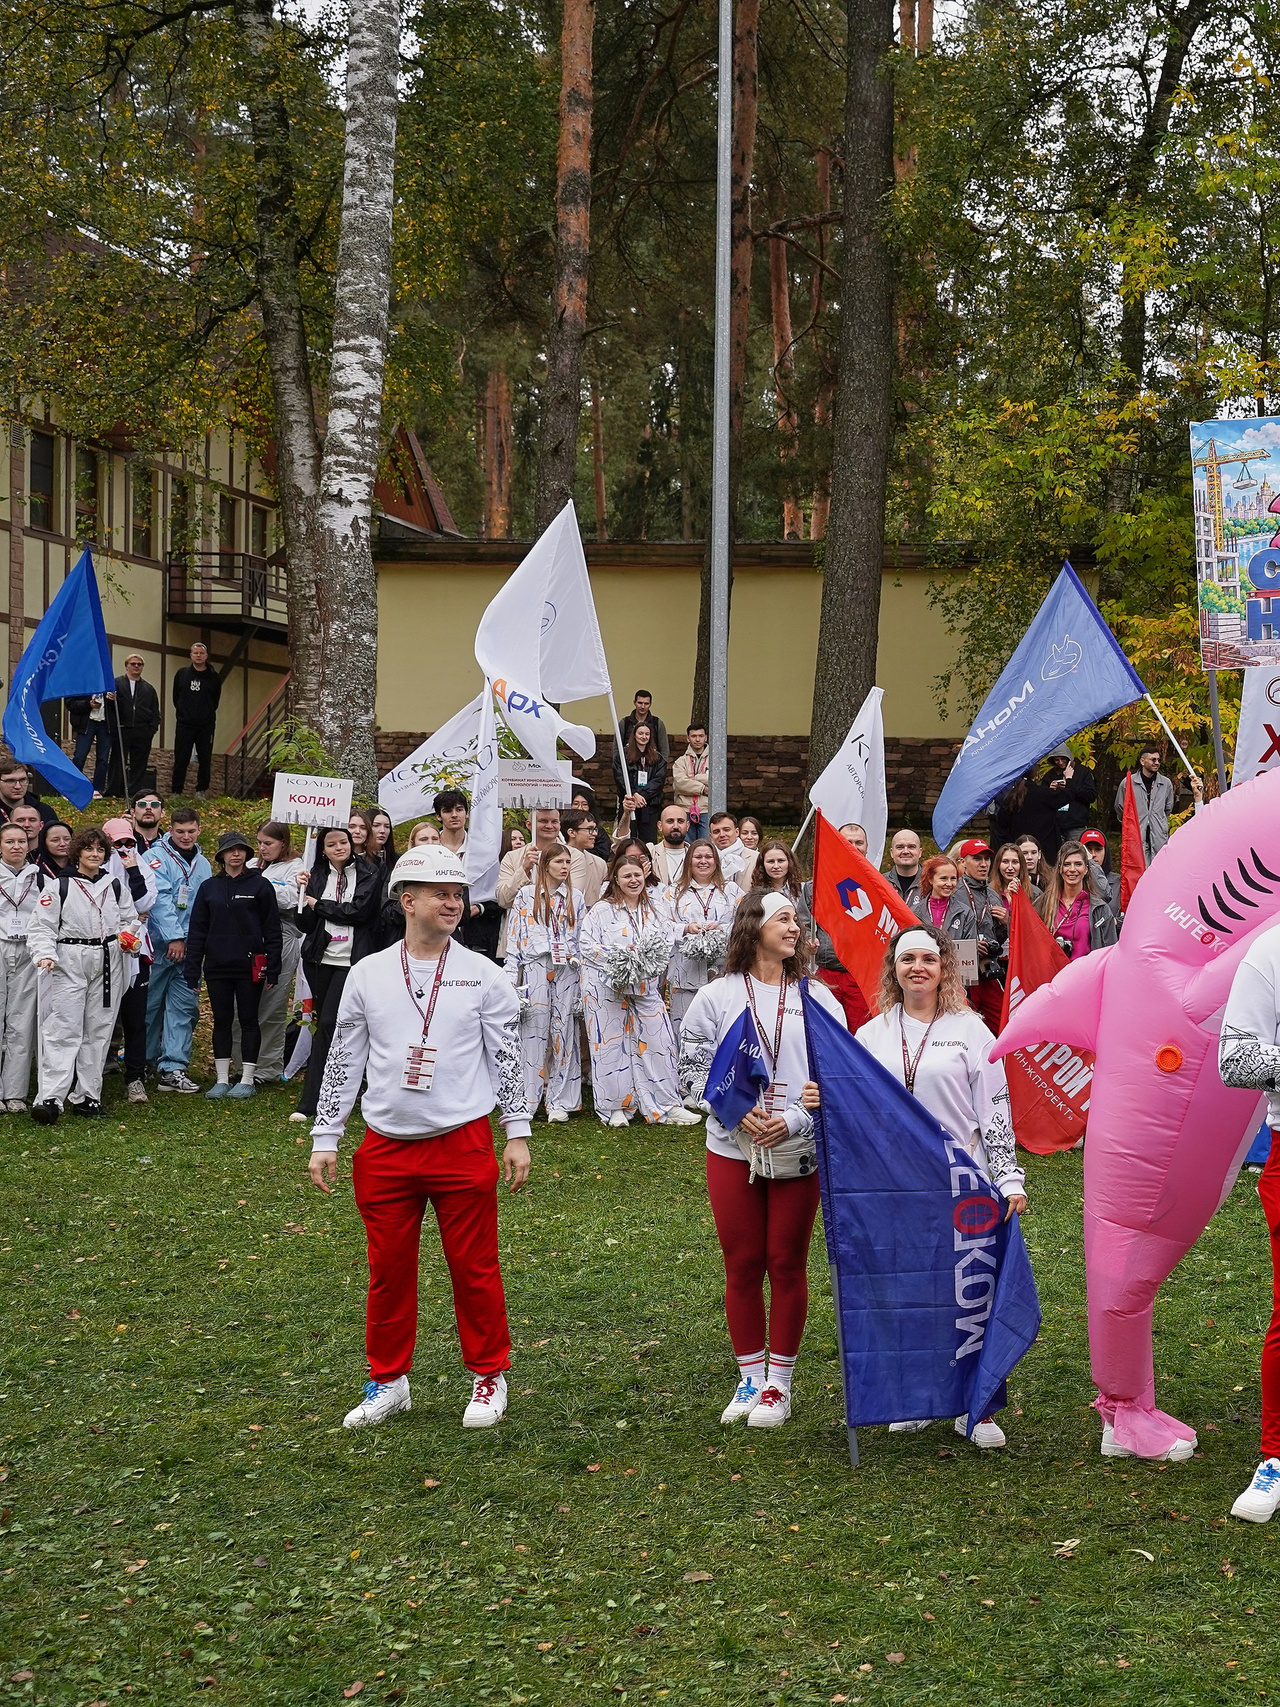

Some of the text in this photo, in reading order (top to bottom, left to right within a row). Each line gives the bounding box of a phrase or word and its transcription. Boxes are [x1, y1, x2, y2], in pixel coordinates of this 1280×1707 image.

[845, 763, 866, 799] АВТОРСК
[289, 793, 336, 807] КОЛДИ
[1013, 1049, 1074, 1122] ИНЖПРОЕКТ»
